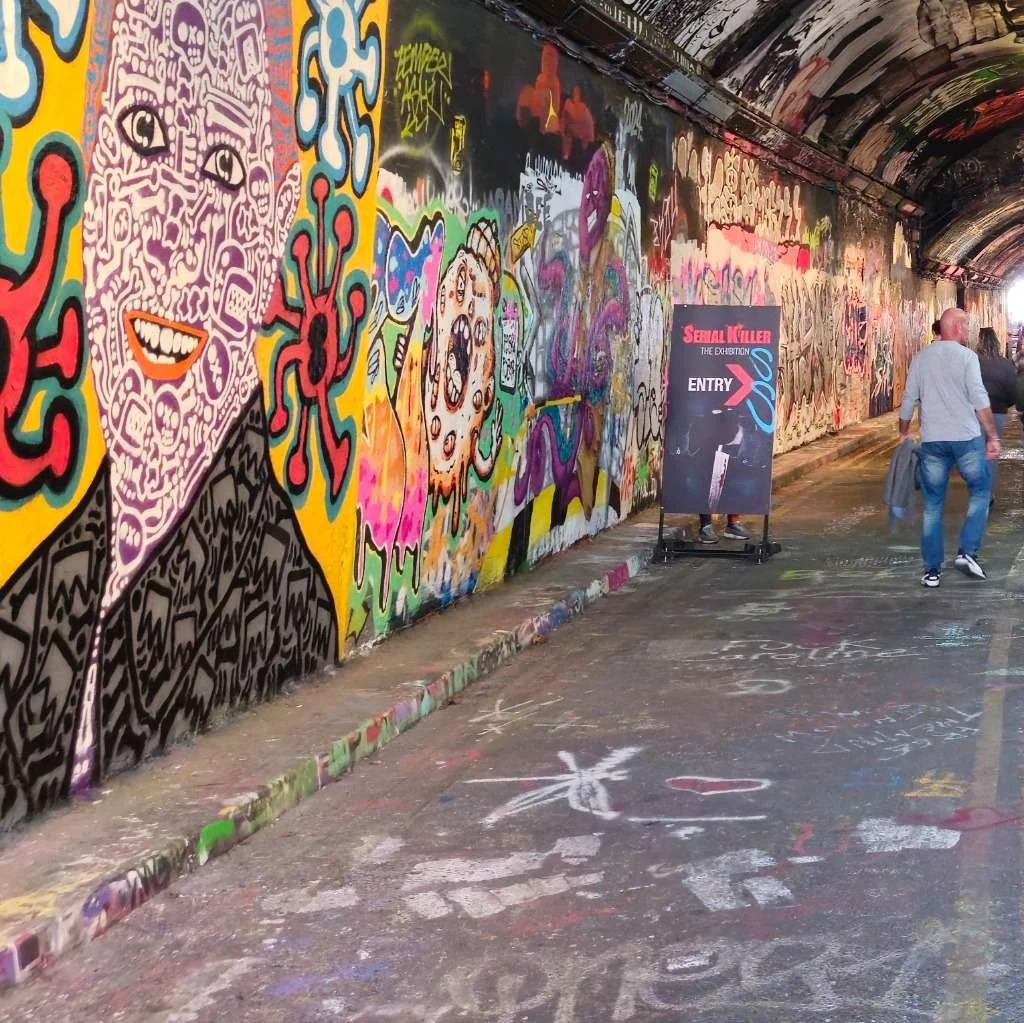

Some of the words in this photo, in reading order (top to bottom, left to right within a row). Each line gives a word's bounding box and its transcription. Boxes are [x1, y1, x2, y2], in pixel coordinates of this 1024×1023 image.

[683, 326, 725, 344] SERIAL
[727, 325, 771, 343] KILLER
[700, 347, 713, 356] THE
[714, 347, 750, 356] EXHIBITION
[688, 377, 734, 392] ENTRY
